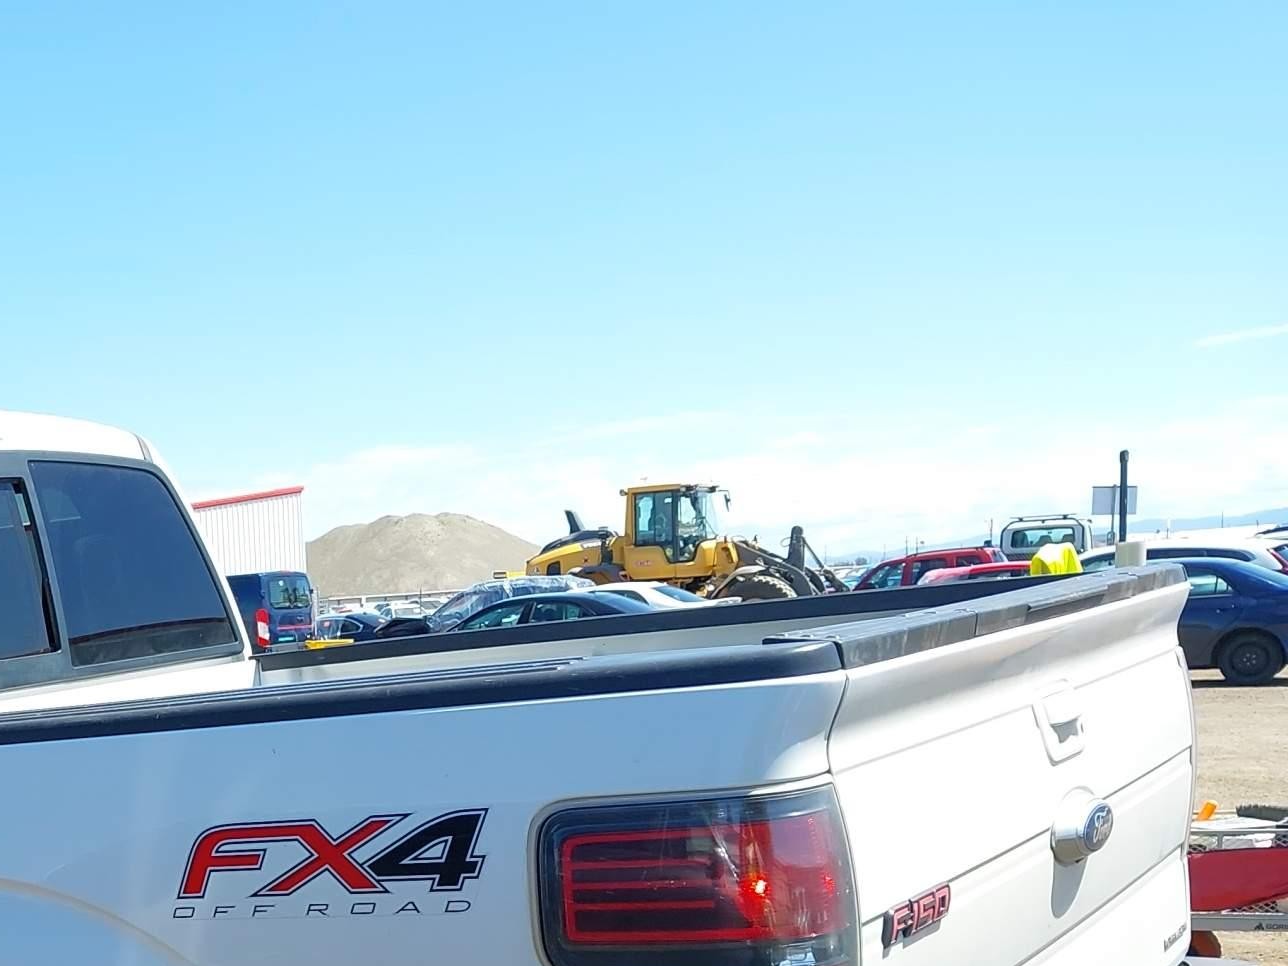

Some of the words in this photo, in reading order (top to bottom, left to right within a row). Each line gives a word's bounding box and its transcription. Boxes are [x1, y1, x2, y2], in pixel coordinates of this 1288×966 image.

[176, 807, 490, 900] FX4
[172, 903, 276, 920] OFF
[306, 899, 472, 917] ROAD
